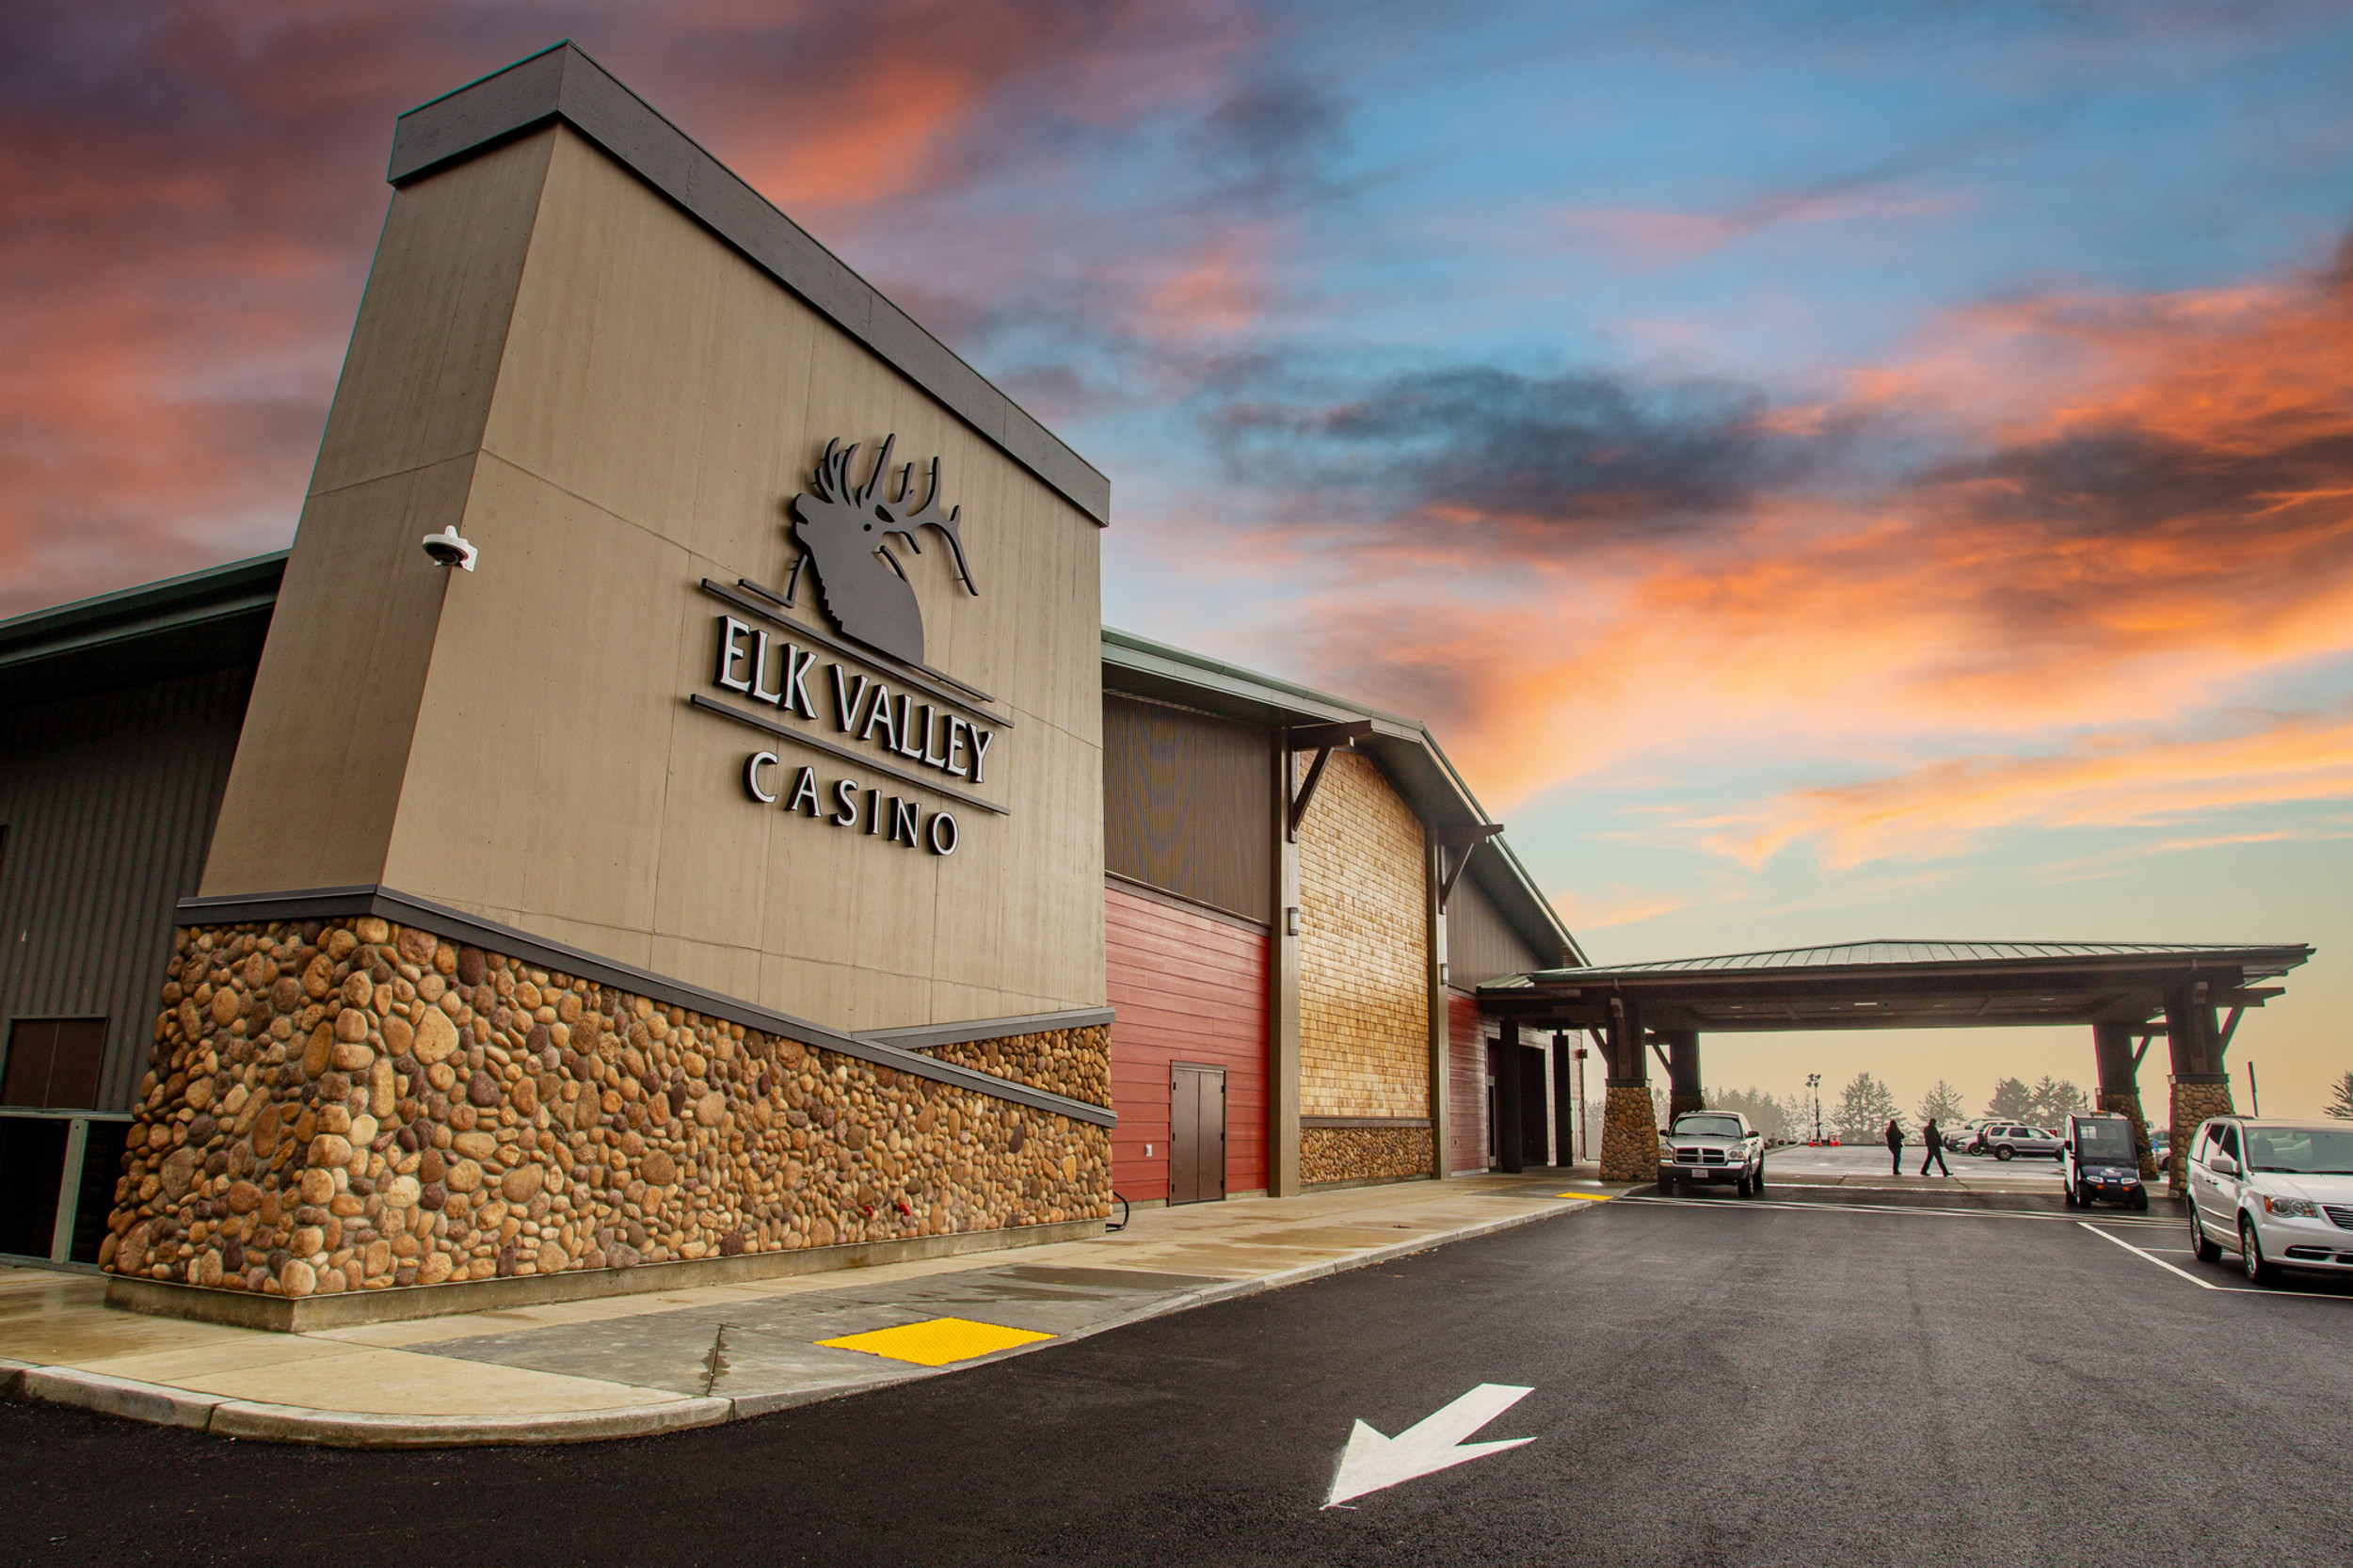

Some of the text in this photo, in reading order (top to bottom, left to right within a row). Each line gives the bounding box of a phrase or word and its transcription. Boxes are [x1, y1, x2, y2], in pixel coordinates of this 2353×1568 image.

[715, 615, 995, 783] ELK VALLEY
[743, 751, 959, 856] CASINO
